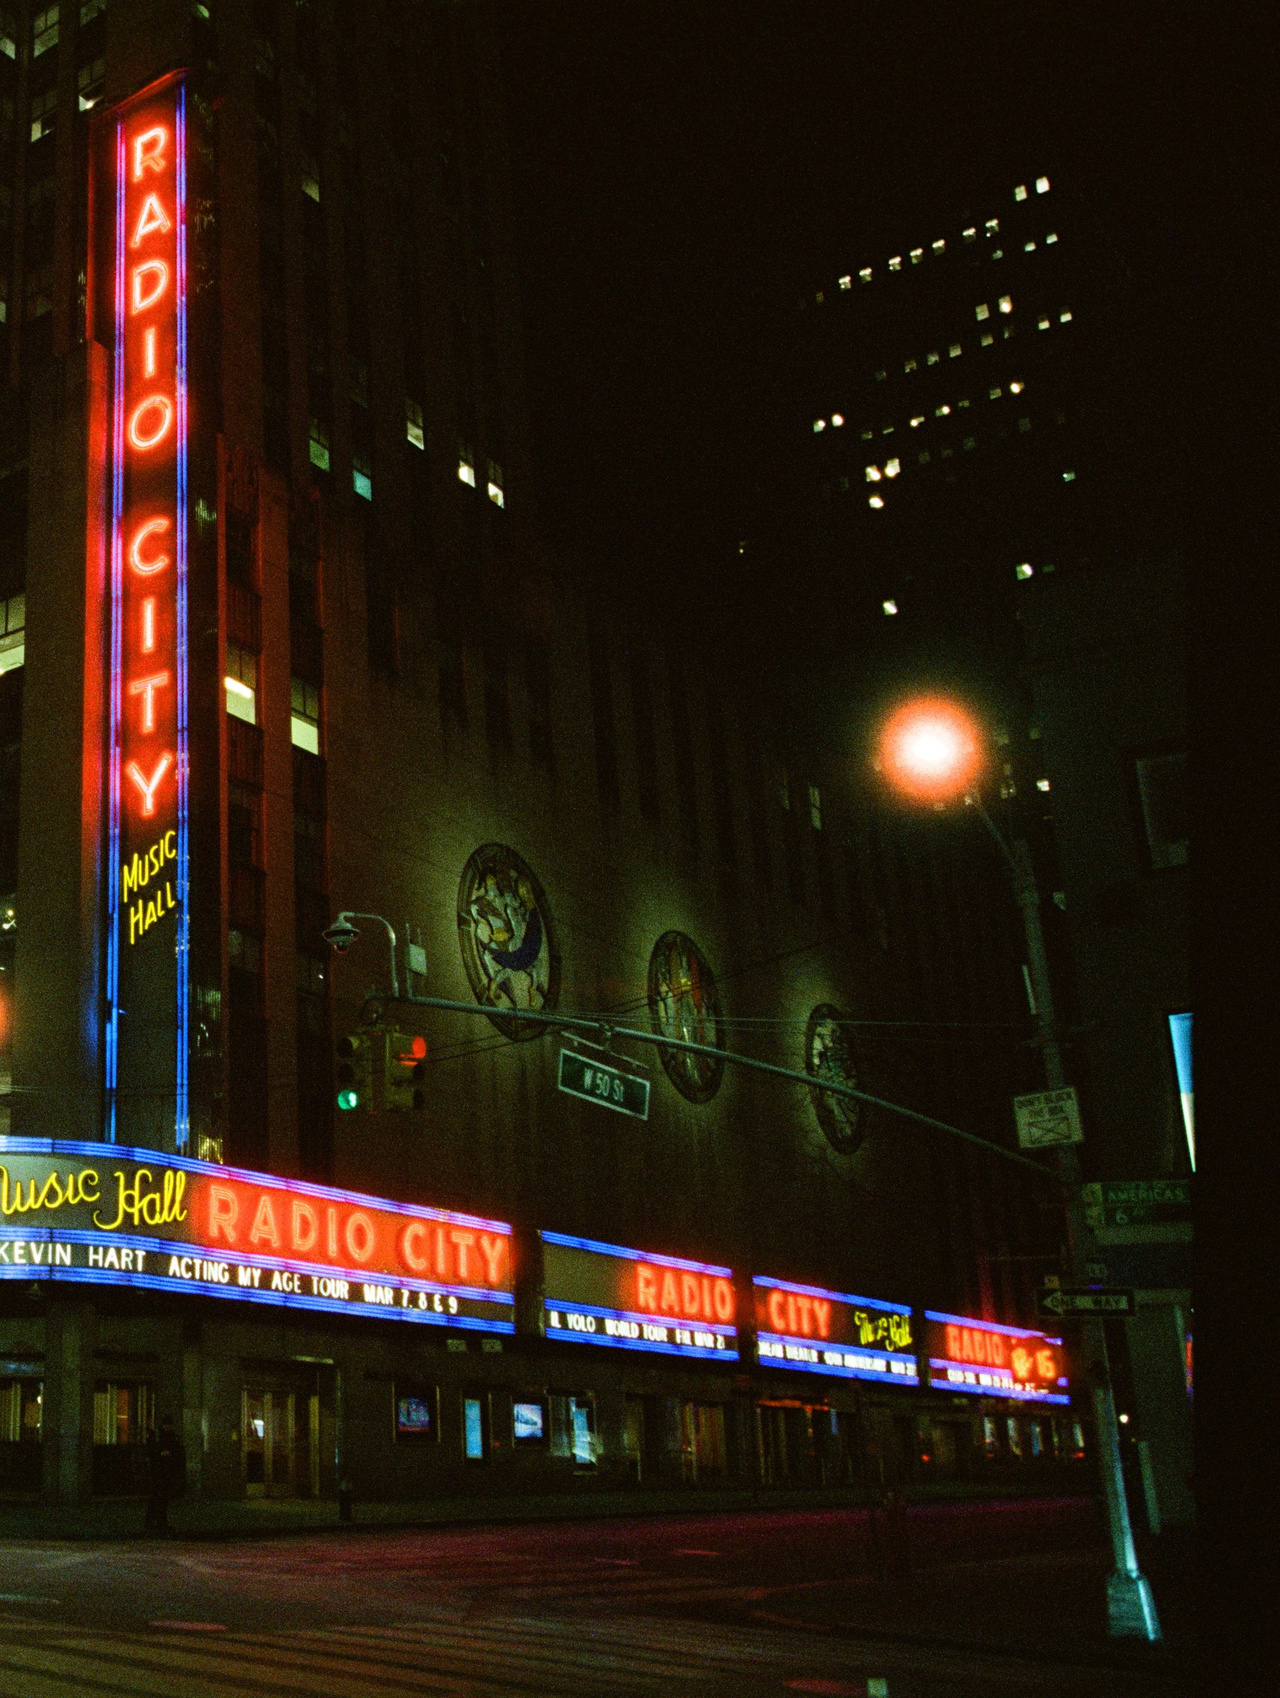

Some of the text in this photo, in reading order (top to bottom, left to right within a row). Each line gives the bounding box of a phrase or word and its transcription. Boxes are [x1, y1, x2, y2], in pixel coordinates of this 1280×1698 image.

[126, 126, 173, 817] RADIO CITY
[583, 1067, 594, 1090] W
[595, 1072, 610, 1097] 50
[92, 1168, 188, 1230] Hall
[209, 1185, 375, 1262] RADIO
[402, 1222, 505, 1282] CITY
[88, 1246, 146, 1271] HART
[169, 1255, 229, 1284] ACTING
[238, 1265, 261, 1288] MY
[271, 1271, 302, 1294] AGE
[312, 1276, 349, 1300] TOUR
[363, 1284, 393, 1306] MAR
[418, 1291, 428, 1310] 8
[448, 1295, 458, 1314] 9
[636, 1263, 735, 1321] RADIO
[567, 1313, 596, 1333] VOLO
[604, 1318, 640, 1339] WORLD
[642, 1323, 668, 1342] TOUR
[769, 1288, 831, 1338] CITY
[946, 1323, 1005, 1365] RADIO
